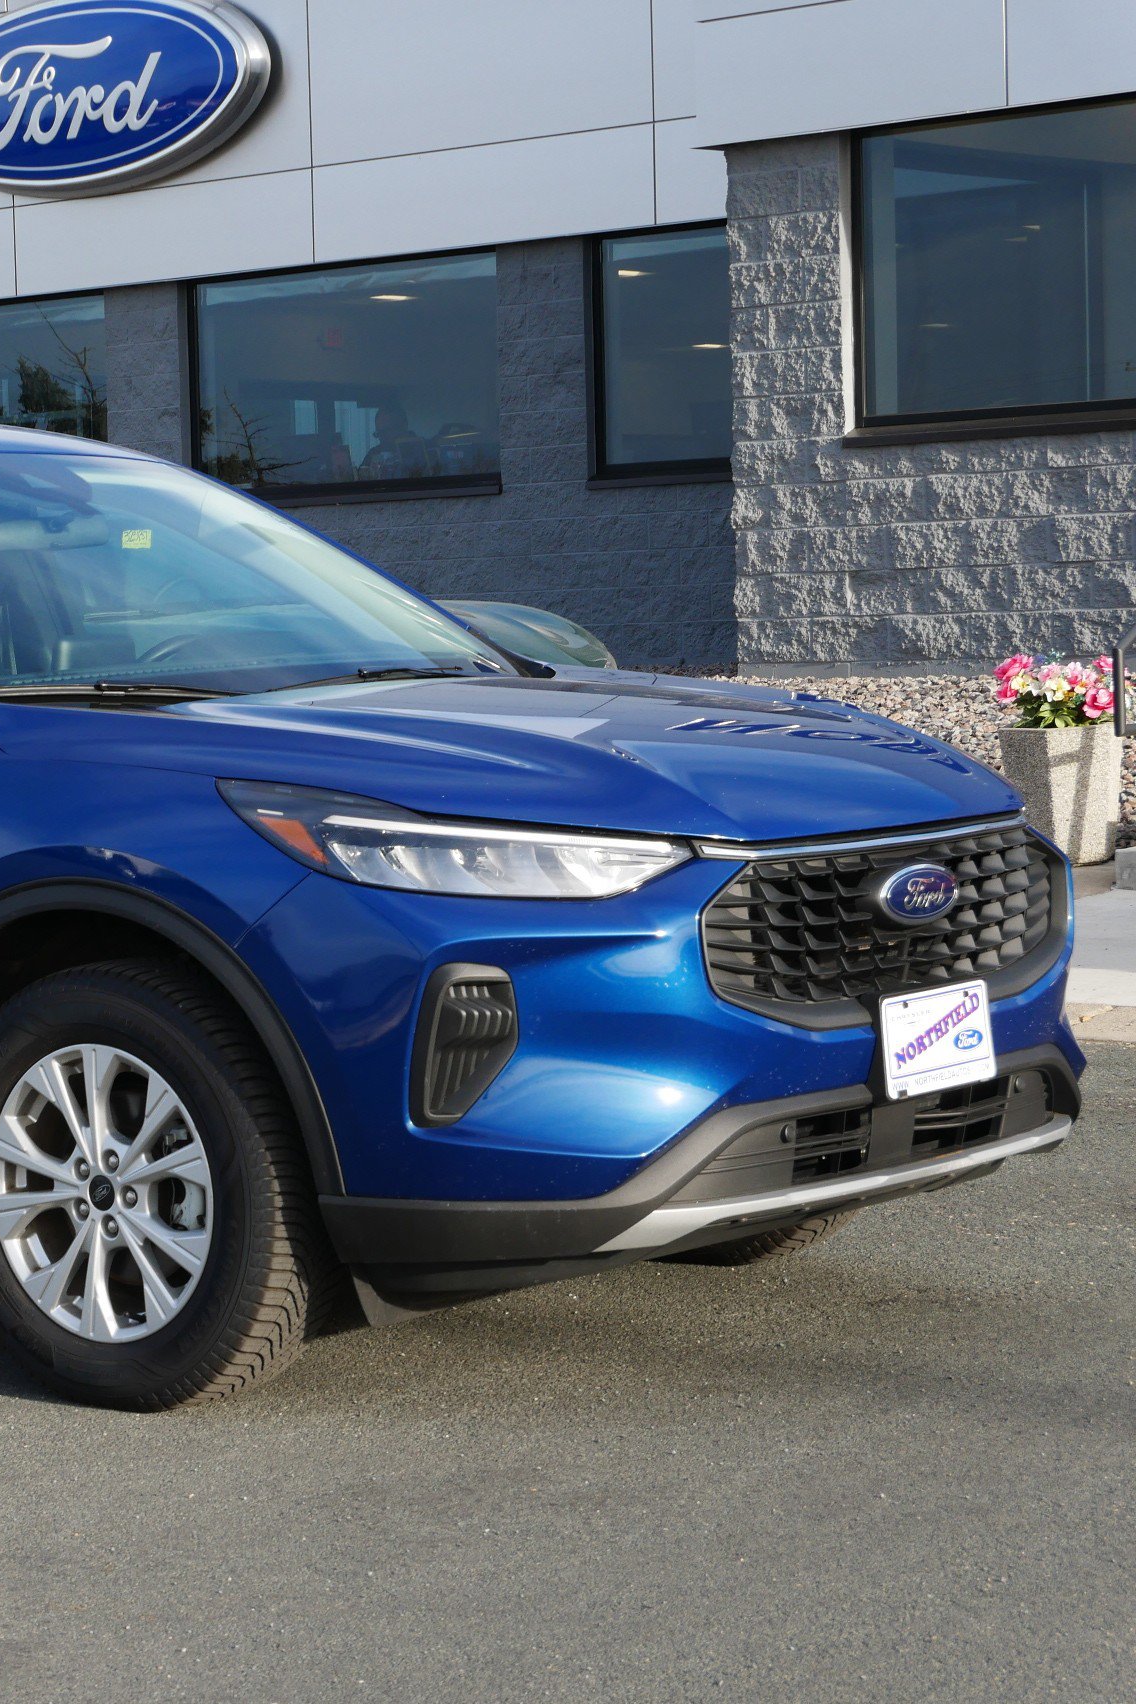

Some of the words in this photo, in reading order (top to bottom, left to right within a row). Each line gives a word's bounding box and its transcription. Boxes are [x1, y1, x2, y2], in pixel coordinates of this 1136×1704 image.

[904, 877, 945, 910] Ford
[894, 992, 980, 1069] NORTHFIELD
[957, 1031, 979, 1048] Ford
